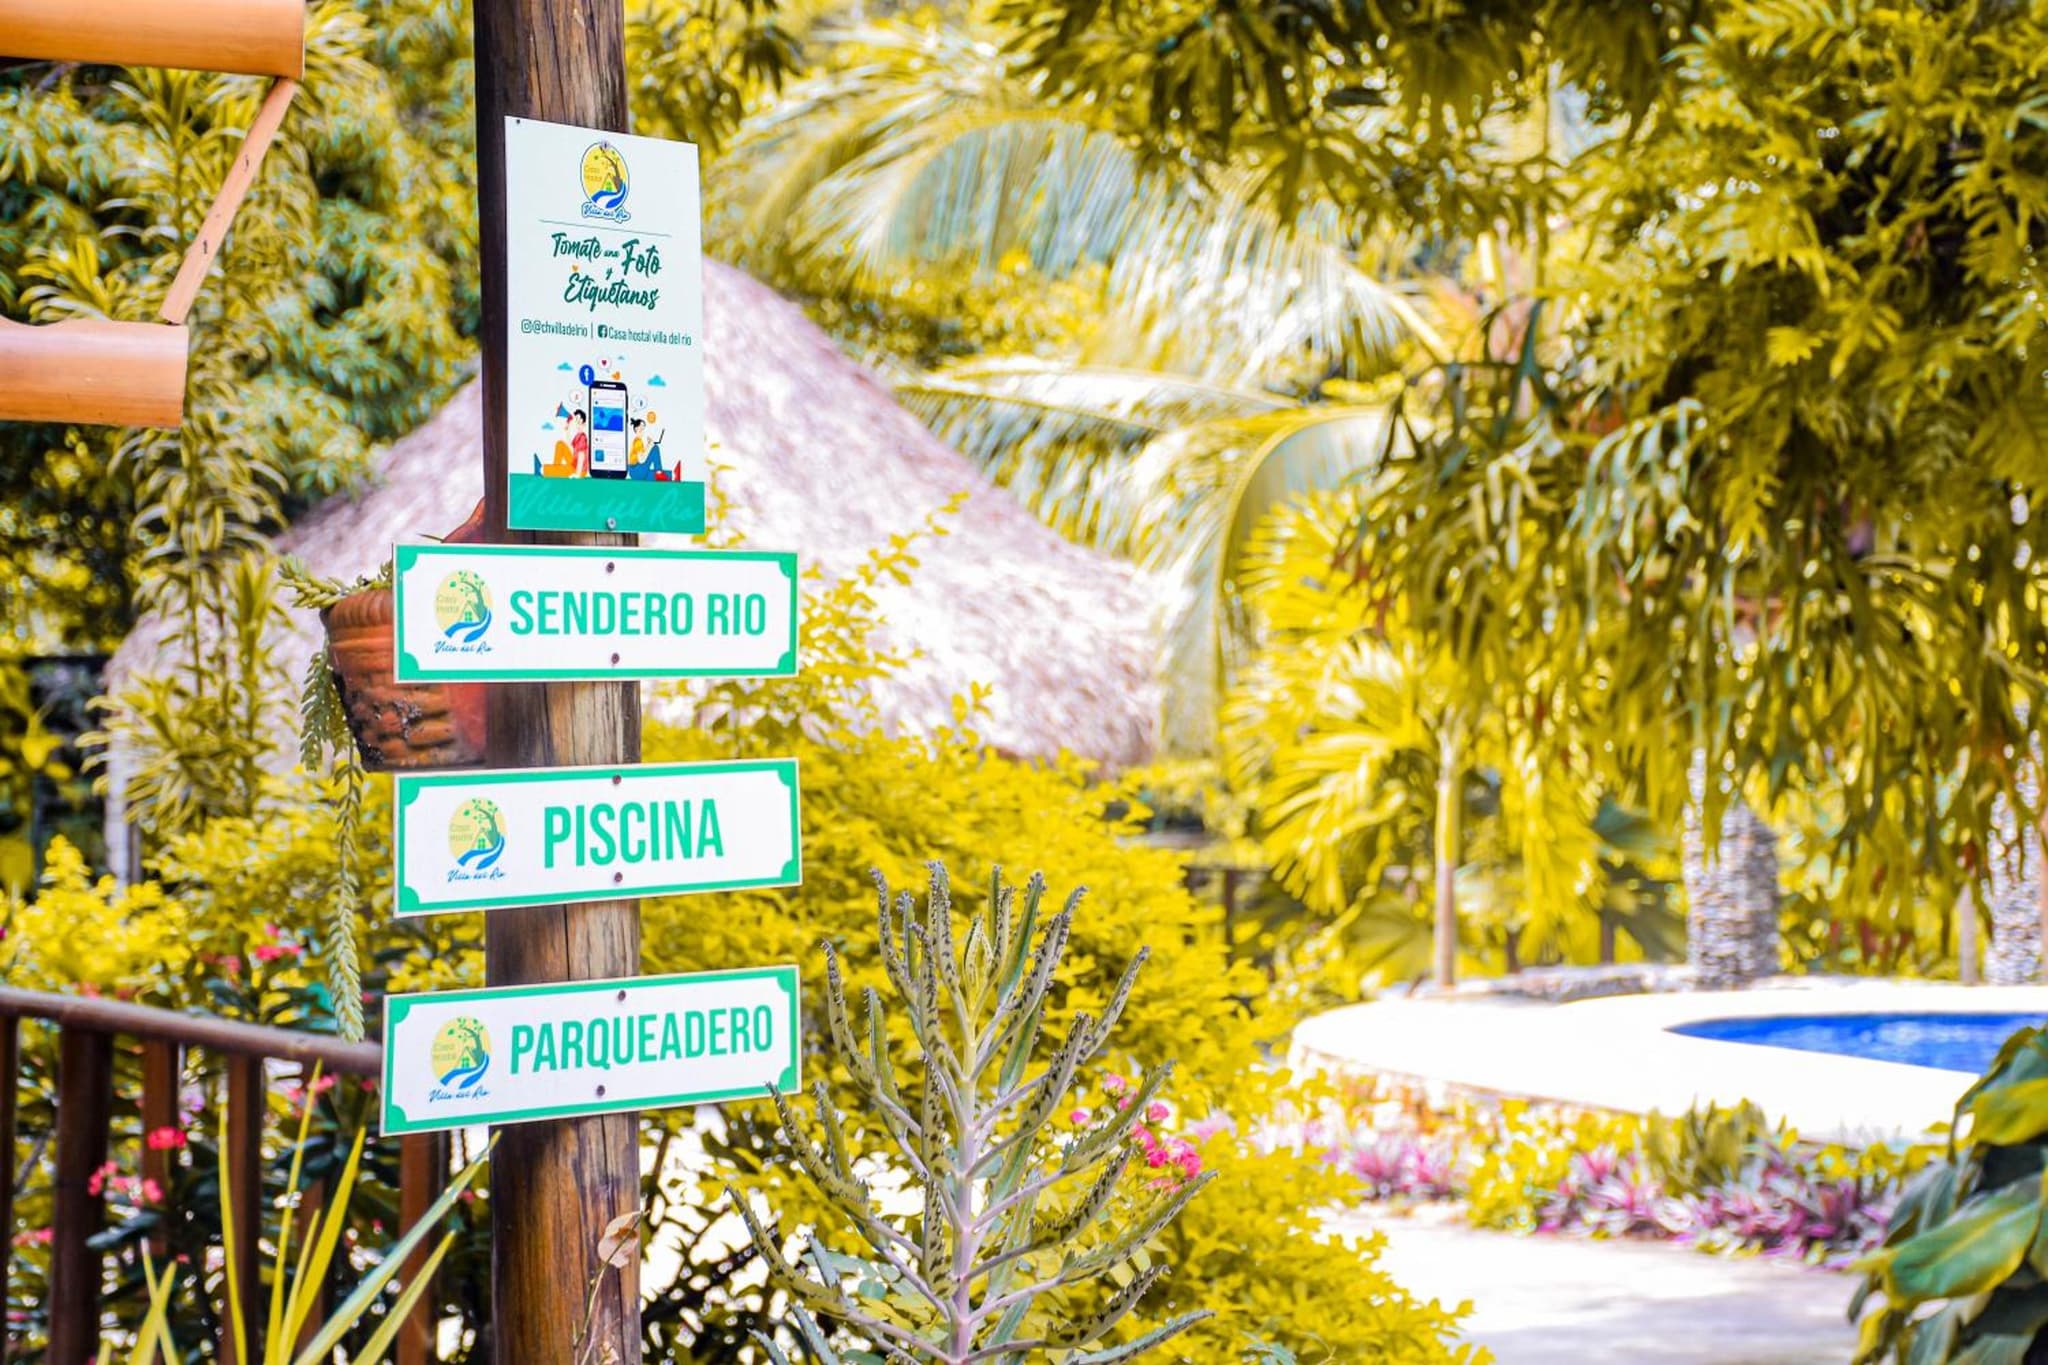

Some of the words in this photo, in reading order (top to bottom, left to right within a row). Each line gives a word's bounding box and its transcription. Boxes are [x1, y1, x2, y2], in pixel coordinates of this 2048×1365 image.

[551, 232, 601, 263] Tomate
[603, 250, 620, 258] una
[621, 238, 662, 278] Foto
[606, 268, 613, 281] y
[564, 272, 661, 312] Etiquetanos
[608, 326, 627, 341] Casa
[628, 328, 651, 343] hostal
[652, 330, 667, 344] villa
[669, 332, 681, 345] del
[682, 333, 692, 346] rio
[510, 591, 693, 635] SENDERO
[707, 593, 765, 635] RIO
[544, 799, 724, 869] PISCINA
[511, 1005, 772, 1074] PARQUEADERO
